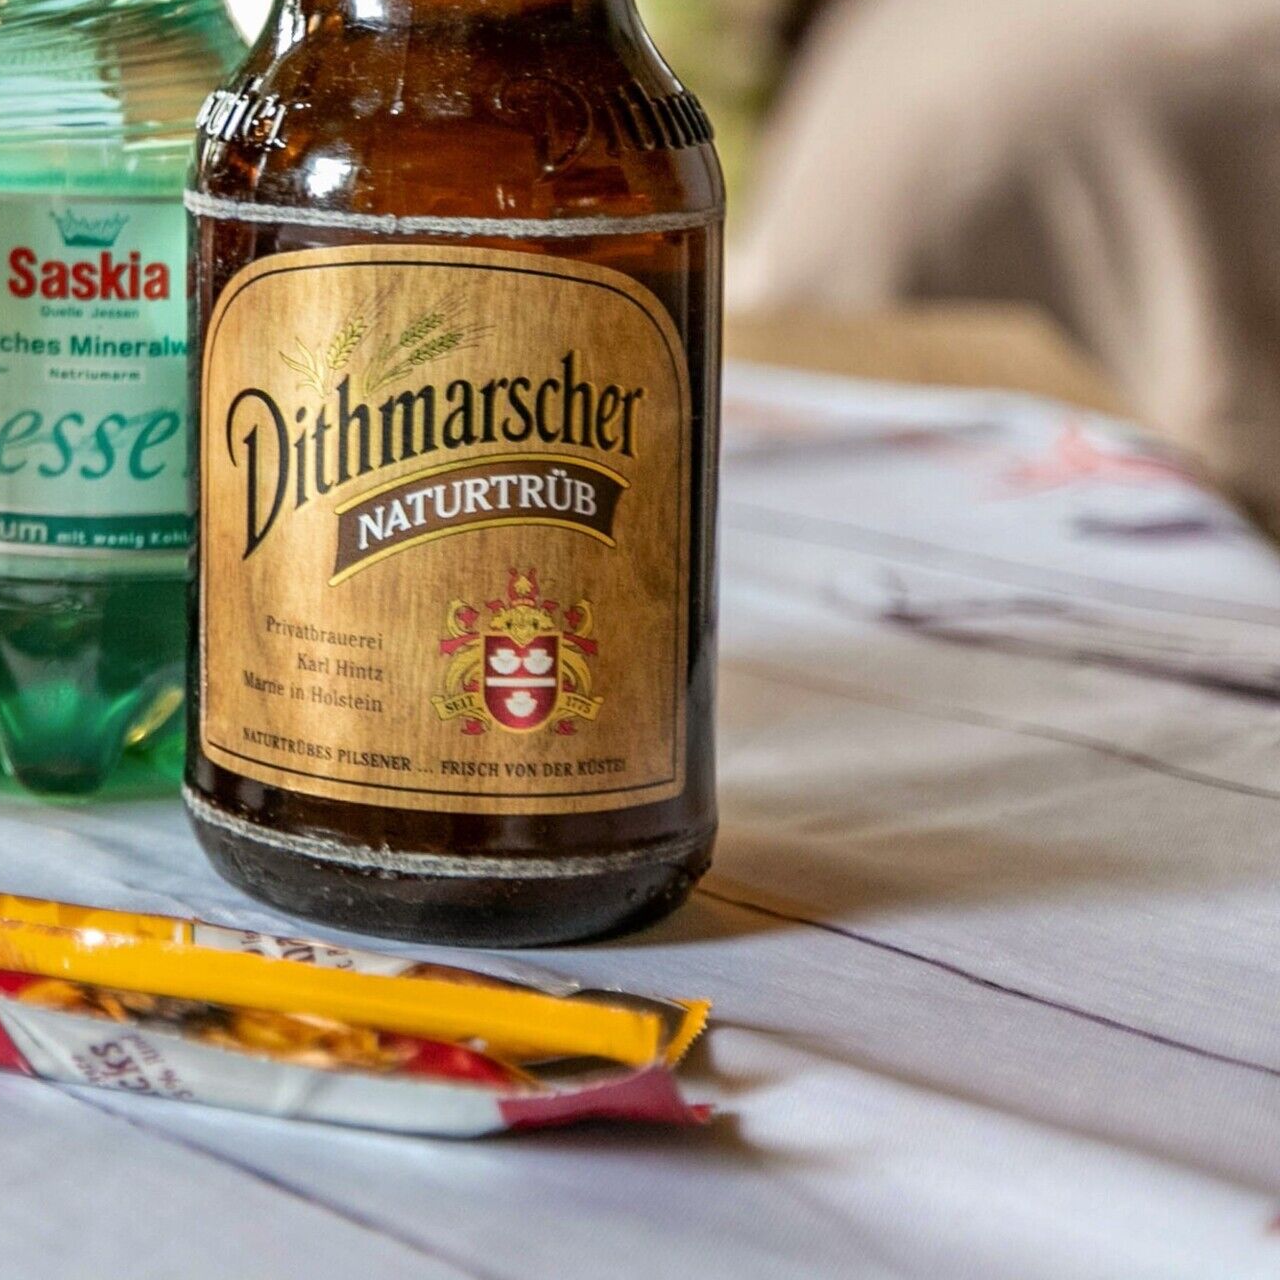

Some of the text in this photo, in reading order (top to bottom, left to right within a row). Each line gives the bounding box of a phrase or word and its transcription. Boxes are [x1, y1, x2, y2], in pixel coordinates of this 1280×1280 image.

[7, 246, 171, 301] Saskia
[226, 350, 643, 562] Dithmarscher
[357, 467, 597, 551] NATURTRÜB
[57, 531, 87, 545] mit
[93, 532, 145, 549] wenig
[266, 615, 384, 650] Privatbrauerei
[297, 652, 383, 682] Karl Hintz
[243, 670, 383, 713] Marne in Holstein
[444, 695, 475, 714] SEIT
[242, 727, 333, 761] NATURTRÜBES
[338, 749, 412, 771] PILSENER
[441, 760, 499, 777] FRISCH
[504, 761, 539, 778] VON
[541, 761, 574, 777] DER
